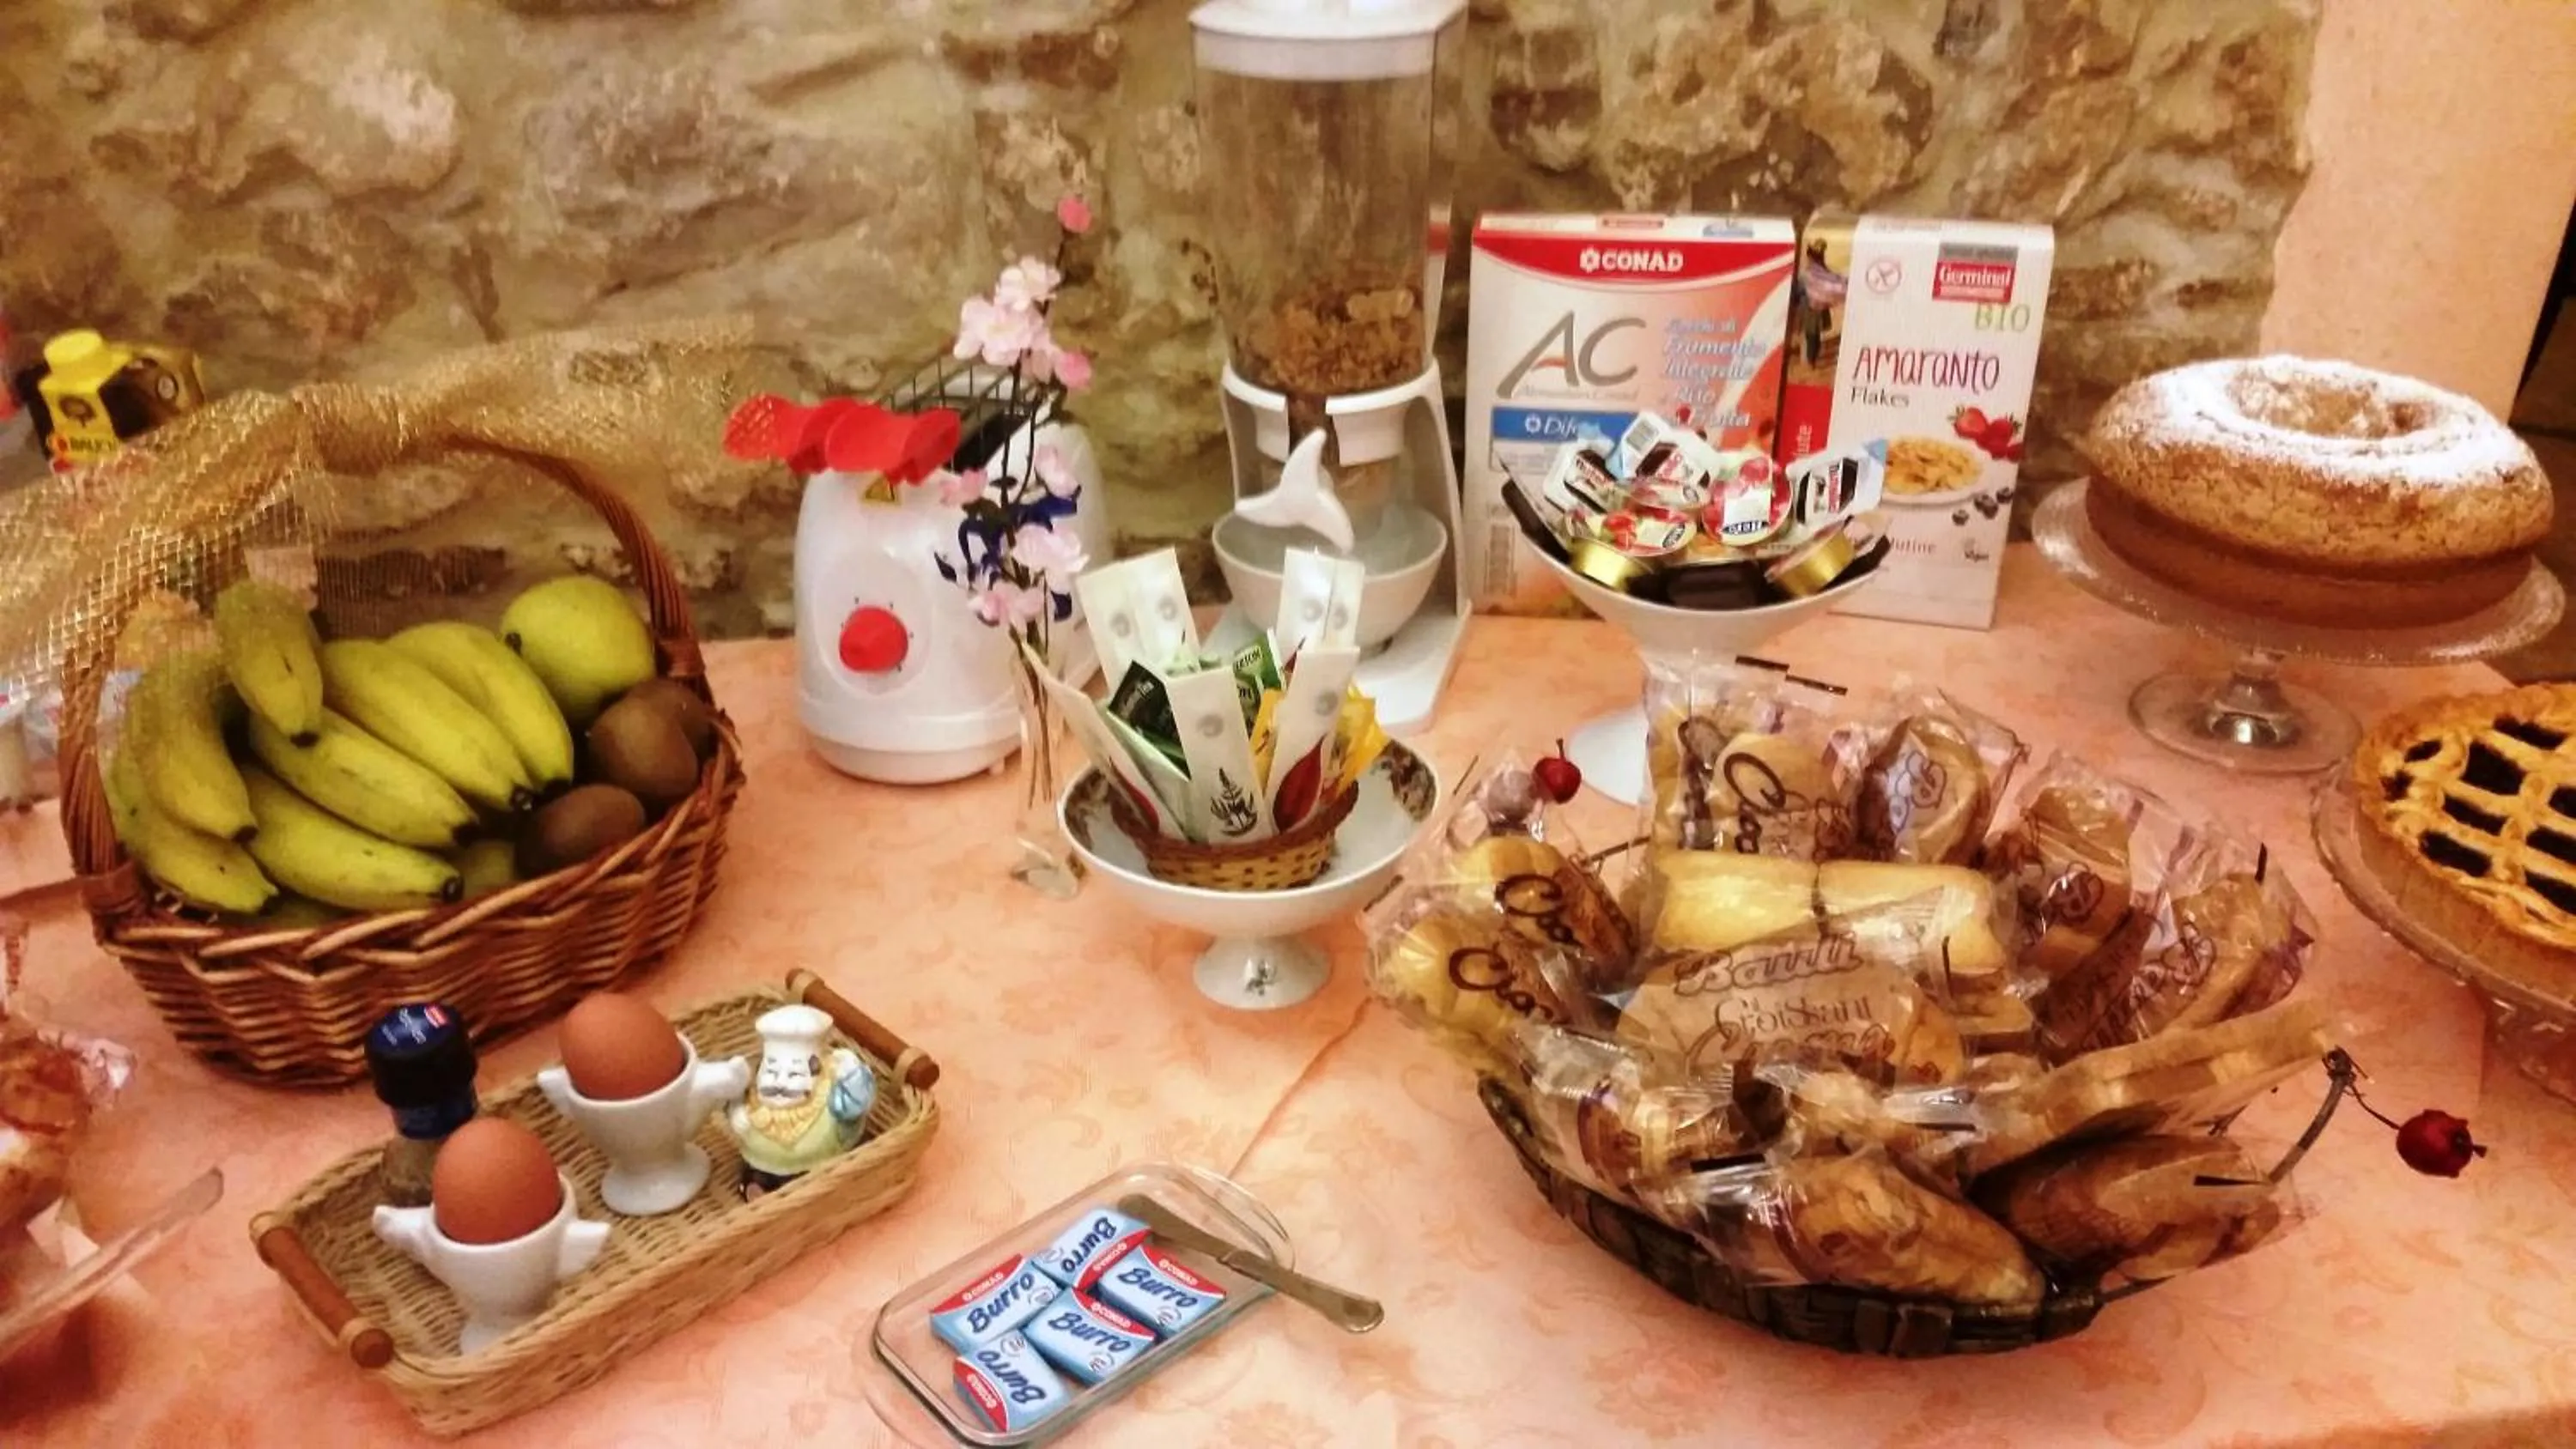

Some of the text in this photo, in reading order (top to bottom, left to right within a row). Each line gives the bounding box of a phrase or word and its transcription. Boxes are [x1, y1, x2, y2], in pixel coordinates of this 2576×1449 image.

[1601, 249, 1684, 272] CONAD
[1940, 263, 2012, 287] Germinal
[1975, 301, 2032, 332] BIO
[1496, 310, 1647, 399] AC
[1850, 386, 1911, 409] Flakes
[1060, 1216, 1118, 1274] Burro
[966, 1271, 1036, 1334] Burro
[1116, 1266, 1199, 1308] Burro
[1048, 1311, 1132, 1353] Burro
[976, 1349, 1048, 1405] Burro
